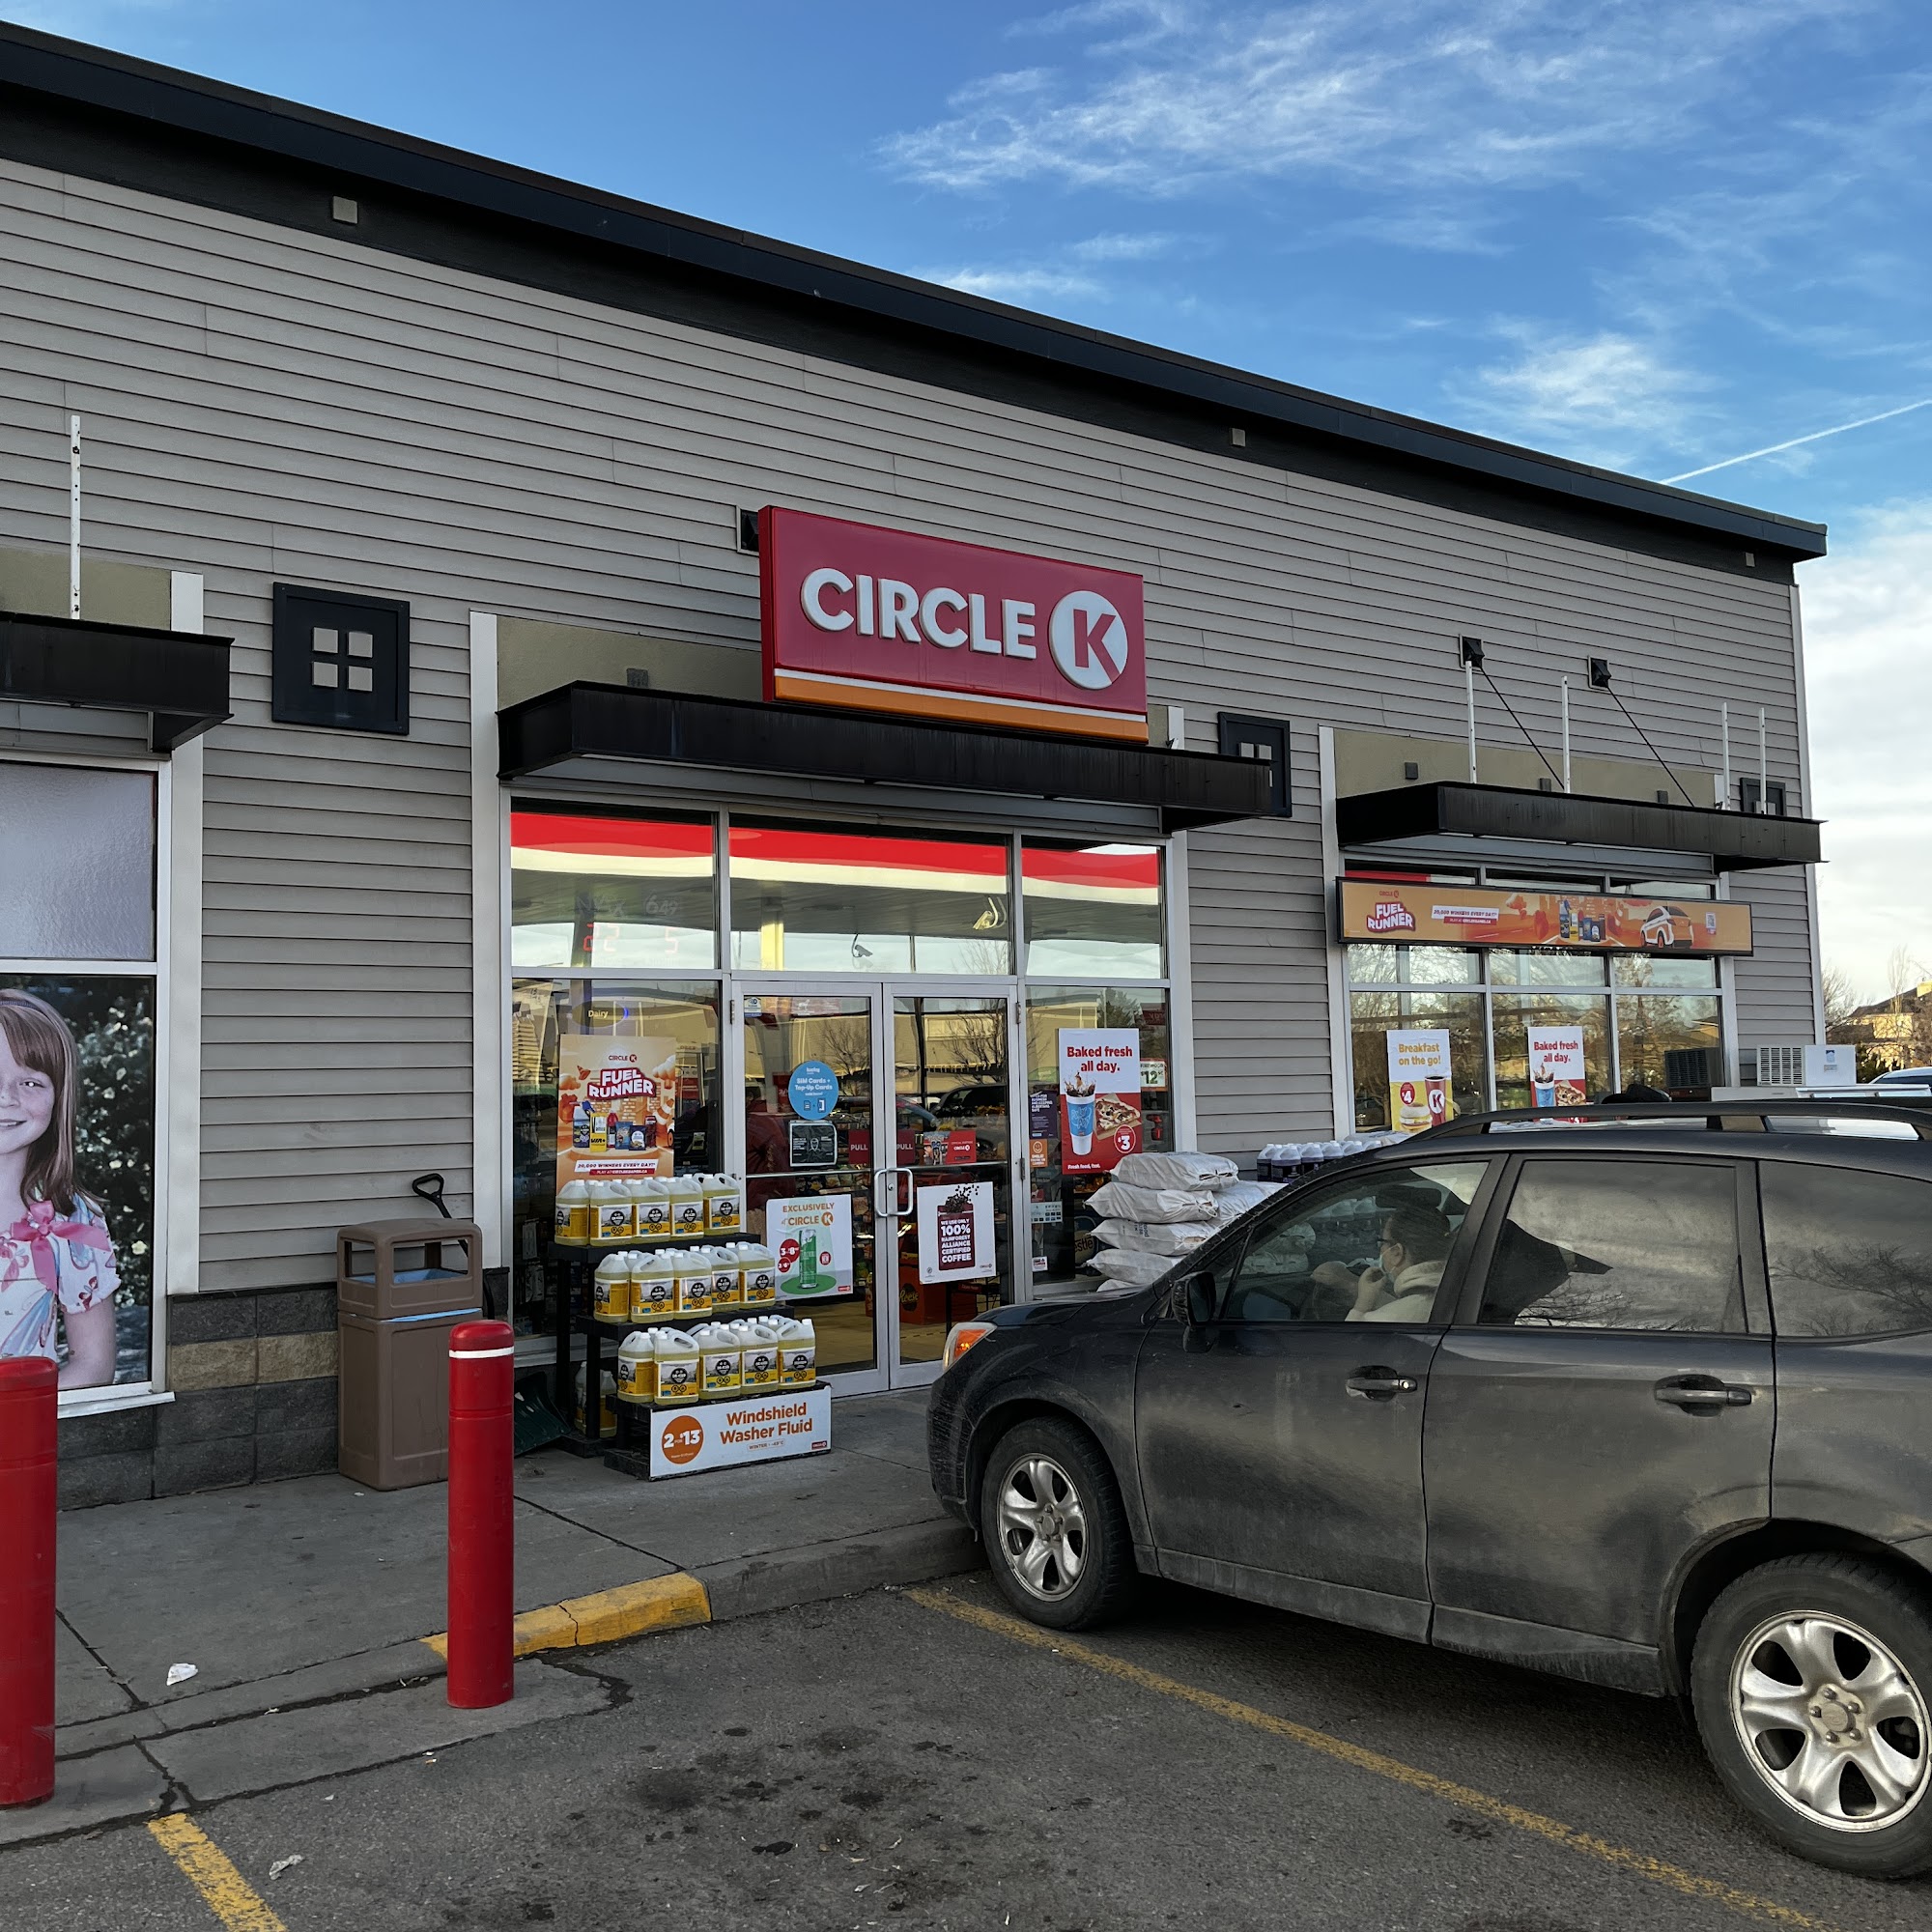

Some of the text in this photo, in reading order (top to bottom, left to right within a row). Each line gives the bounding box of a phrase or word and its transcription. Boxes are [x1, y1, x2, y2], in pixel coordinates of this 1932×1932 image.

[801, 567, 1122, 687] CIRCLE K
[1376, 903, 1405, 919] FUEL
[1367, 913, 1412, 930] RUNNER
[587, 1009, 609, 1018] Dairy
[1398, 1043, 1439, 1053] Breakfast
[1533, 1040, 1578, 1051] Baked fresh
[1066, 1046, 1132, 1058] Baked fresh
[1410, 1056, 1425, 1065] the
[1427, 1055, 1441, 1066] go!
[1543, 1053, 1571, 1065] all day.
[1080, 1061, 1121, 1073] all day.
[602, 1069, 641, 1086] FUEL
[589, 1079, 654, 1097] RUNNER
[1432, 1094, 1444, 1110] K
[1117, 1135, 1131, 1151] $3
[782, 1203, 835, 1213] EXCLUSIVELY
[788, 1215, 819, 1226] CIRCLE
[822, 1212, 834, 1226] K
[940, 1224, 971, 1236] 100%
[941, 1240, 971, 1249] ALLIANCE
[781, 1247, 786, 1256] 3
[941, 1253, 972, 1264] COFFEE
[726, 1402, 807, 1427] Windshield
[720, 1418, 813, 1445] Washer Fluid
[663, 1433, 675, 1449] 2
